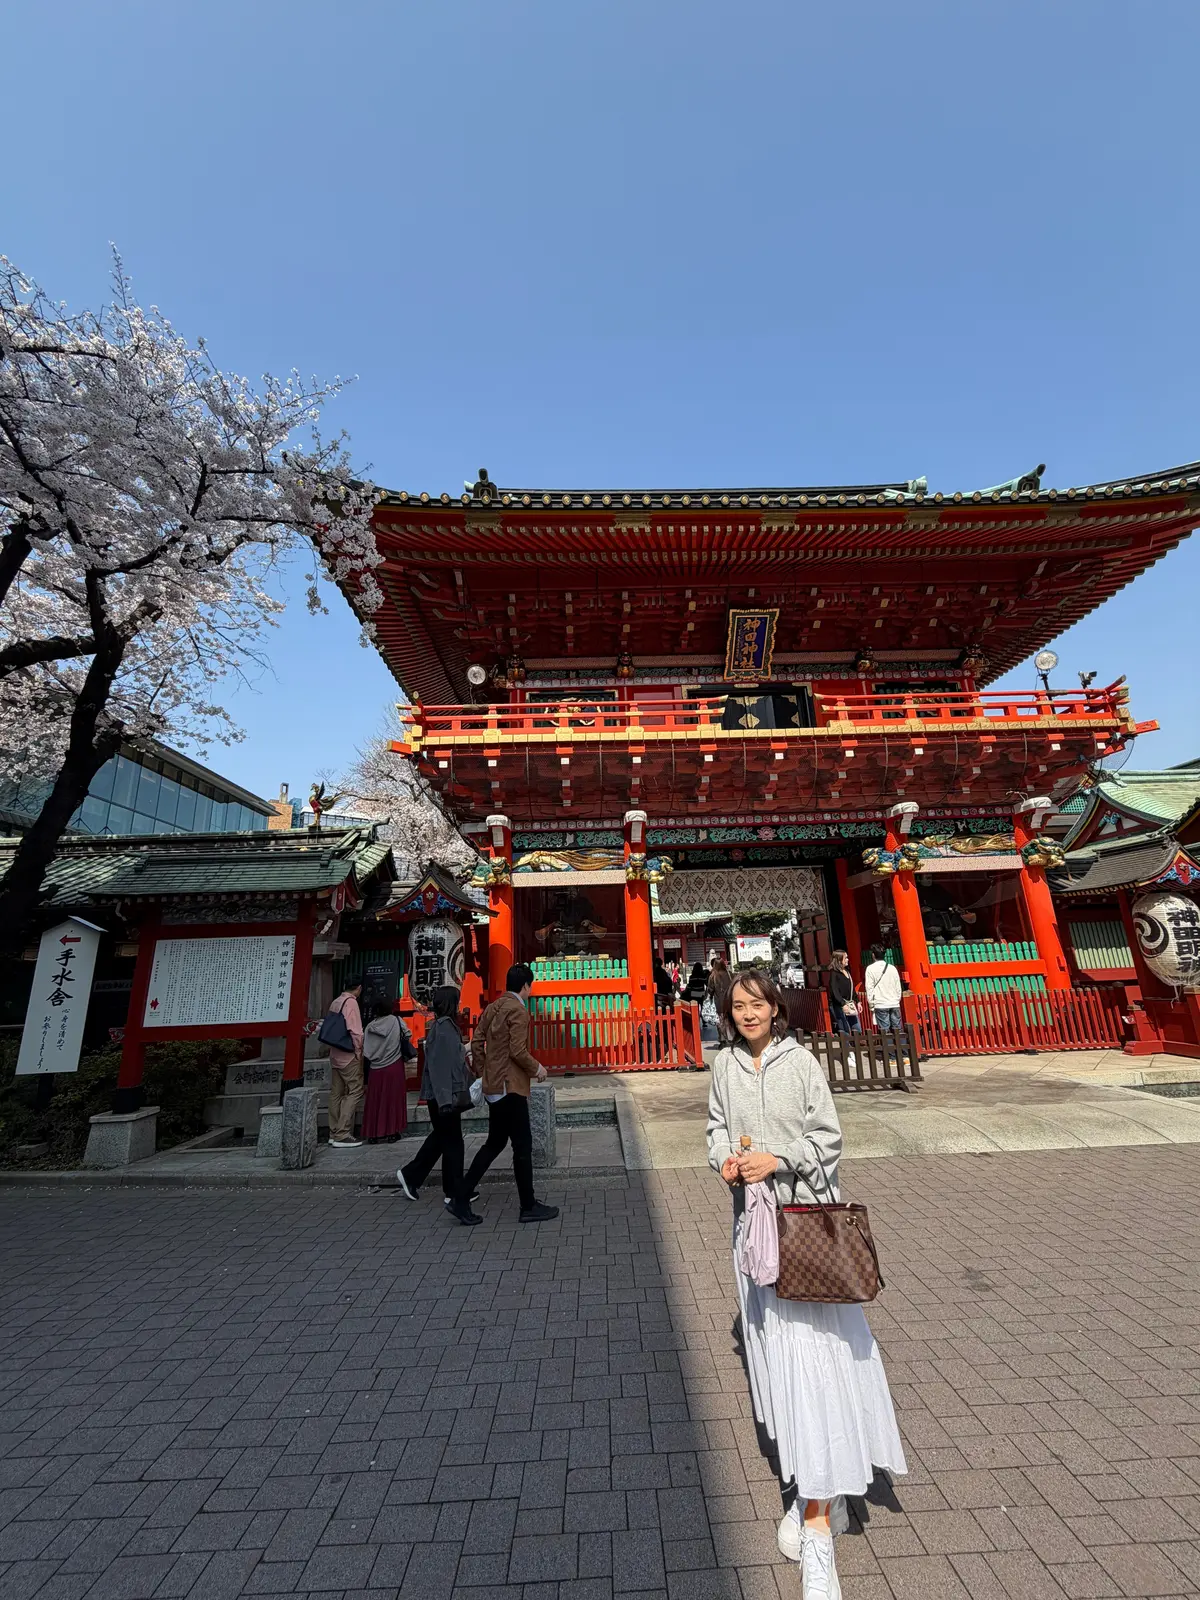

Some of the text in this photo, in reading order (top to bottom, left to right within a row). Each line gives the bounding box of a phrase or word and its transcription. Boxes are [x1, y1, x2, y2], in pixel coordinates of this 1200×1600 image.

[740, 617, 761, 668] 神田神社
[46, 949, 76, 1007] 手水舎
[275, 939, 291, 1010] 神田神社御由緒
[37, 1015, 52, 1070] お参りしましょう
[56, 1008, 71, 1051] 心身を清めて
